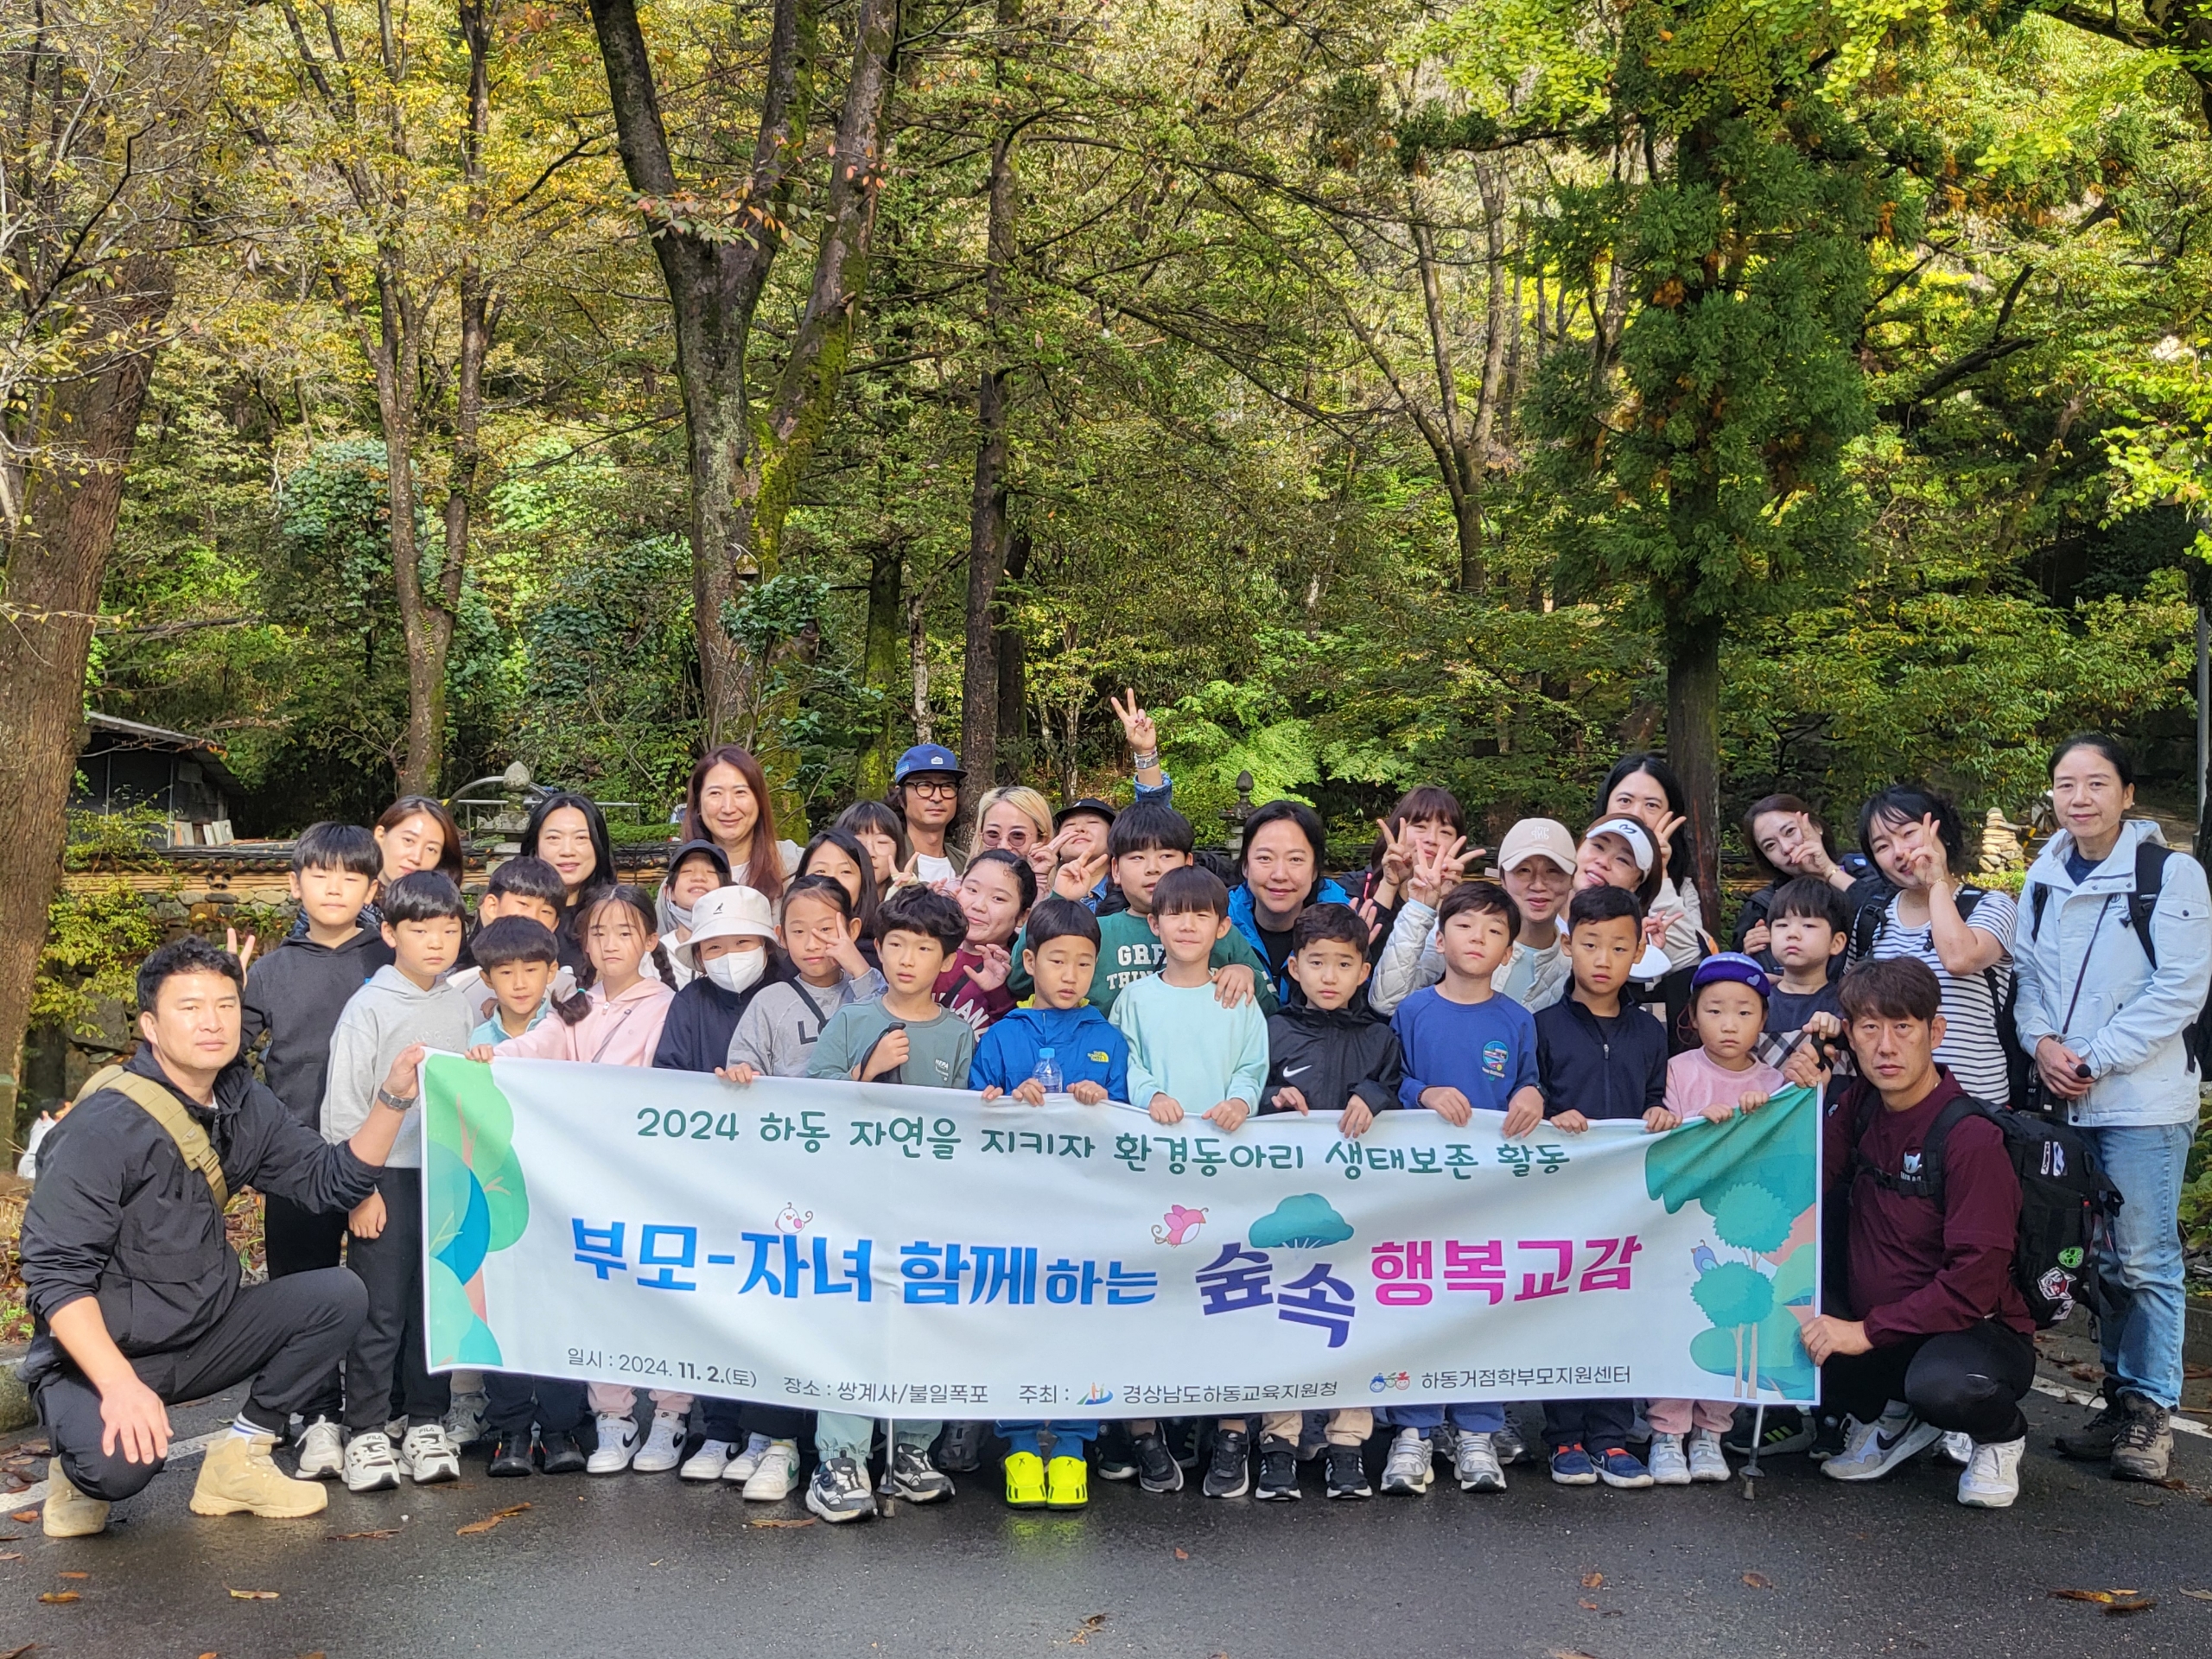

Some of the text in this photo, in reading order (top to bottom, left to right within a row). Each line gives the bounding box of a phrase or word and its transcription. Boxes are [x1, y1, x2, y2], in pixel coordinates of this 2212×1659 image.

[637, 1107, 1571, 1180] 2024 하동 자연을 지키자 환경동아리 생태보존 활동
[571, 1217, 1643, 1349] 부모-자녀 함께하는 숲속 행복교감
[568, 1347, 602, 1369] 일시
[619, 1353, 673, 1377] 2024.
[677, 1361, 702, 1381] 11.
[706, 1365, 757, 1389] 2.(토)
[1421, 1365, 1631, 1389] 하동거점학부모지원센터
[783, 1376, 821, 1397] 장소
[836, 1381, 989, 1405] 쌍계사/불일폭포
[1018, 1384, 1058, 1405] 주최
[1122, 1381, 1338, 1405] 경상남도하동교육지원청
